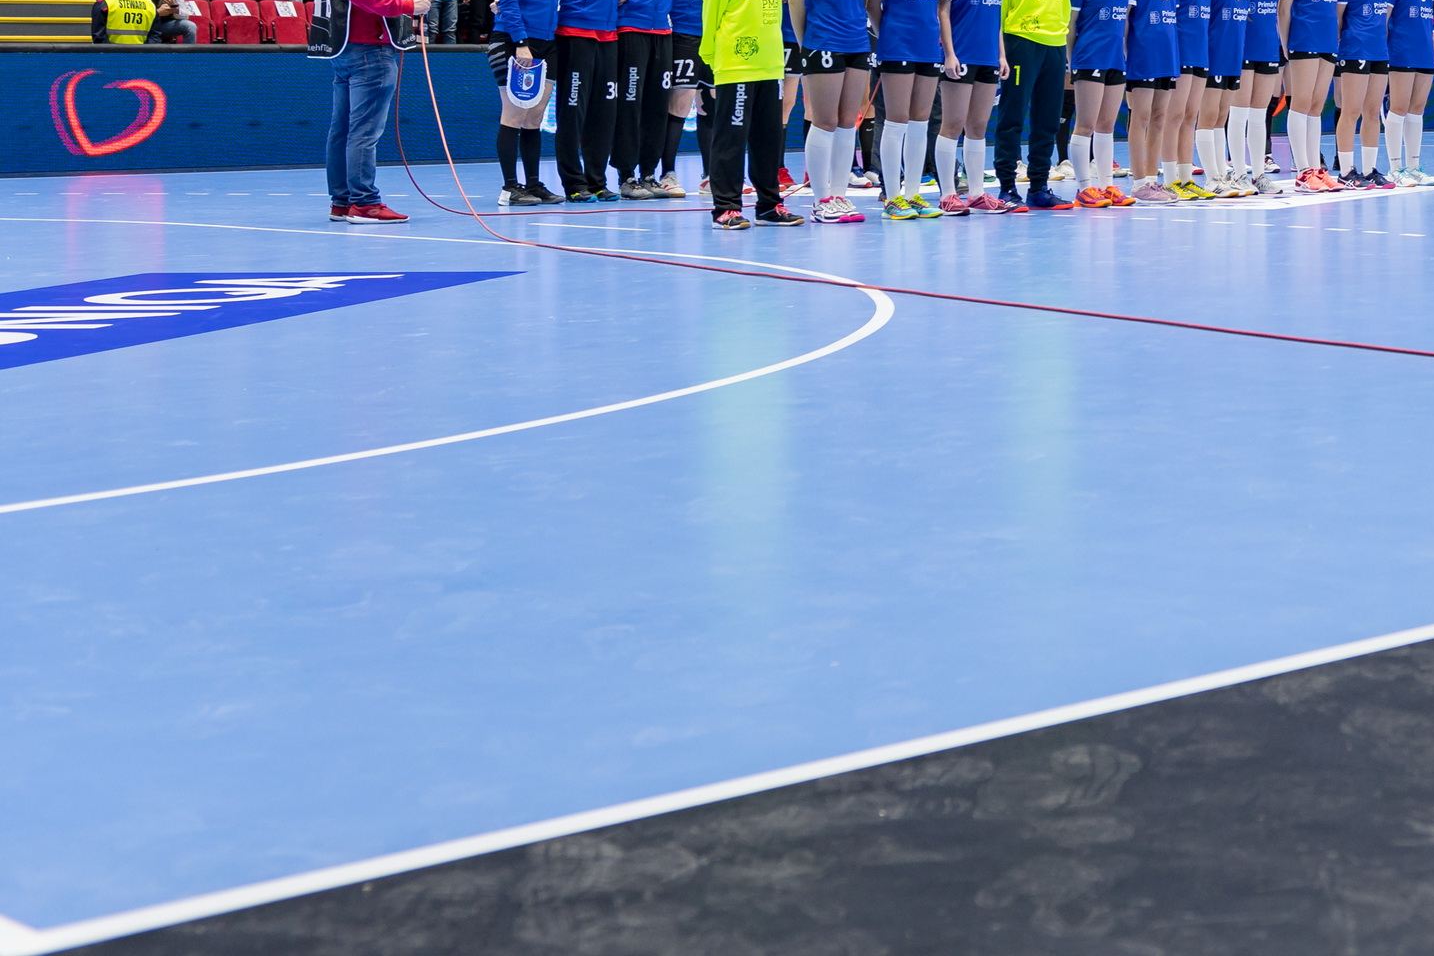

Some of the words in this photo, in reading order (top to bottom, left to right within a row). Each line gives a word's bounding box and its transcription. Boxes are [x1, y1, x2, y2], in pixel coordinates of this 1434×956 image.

[118, 0, 147, 11] STEWARD
[124, 12, 142, 25] 073
[674, 59, 695, 77] 72
[821, 50, 832, 68] 8
[626, 67, 640, 101] Kempa
[662, 71, 673, 89] 8
[1013, 65, 1021, 86] 1
[568, 72, 582, 106] Kempa
[731, 84, 748, 126] Kempa
